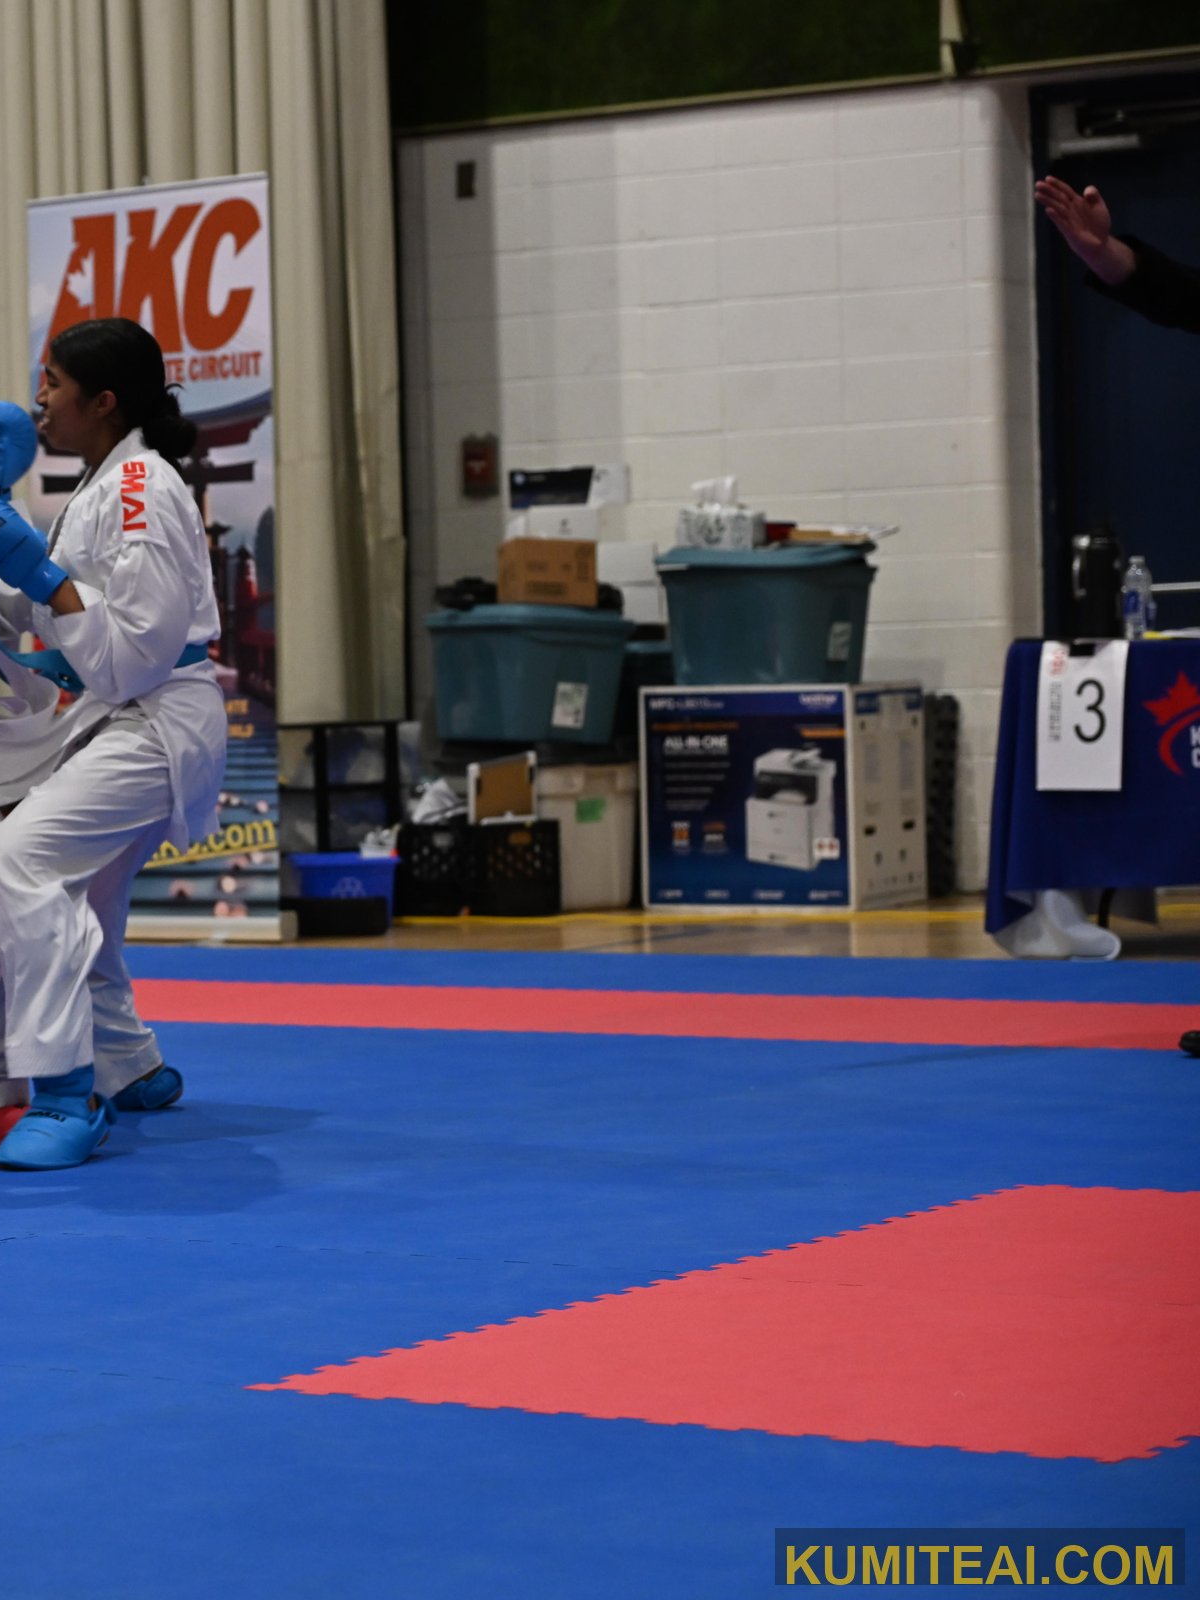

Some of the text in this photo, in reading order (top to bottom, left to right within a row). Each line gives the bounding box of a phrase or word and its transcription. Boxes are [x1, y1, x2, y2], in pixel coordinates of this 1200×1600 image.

[40, 198, 261, 364] AKC
[188, 351, 262, 381] CIRCUIT
[121, 460, 147, 531] SMAI
[1074, 677, 1106, 744] 3
